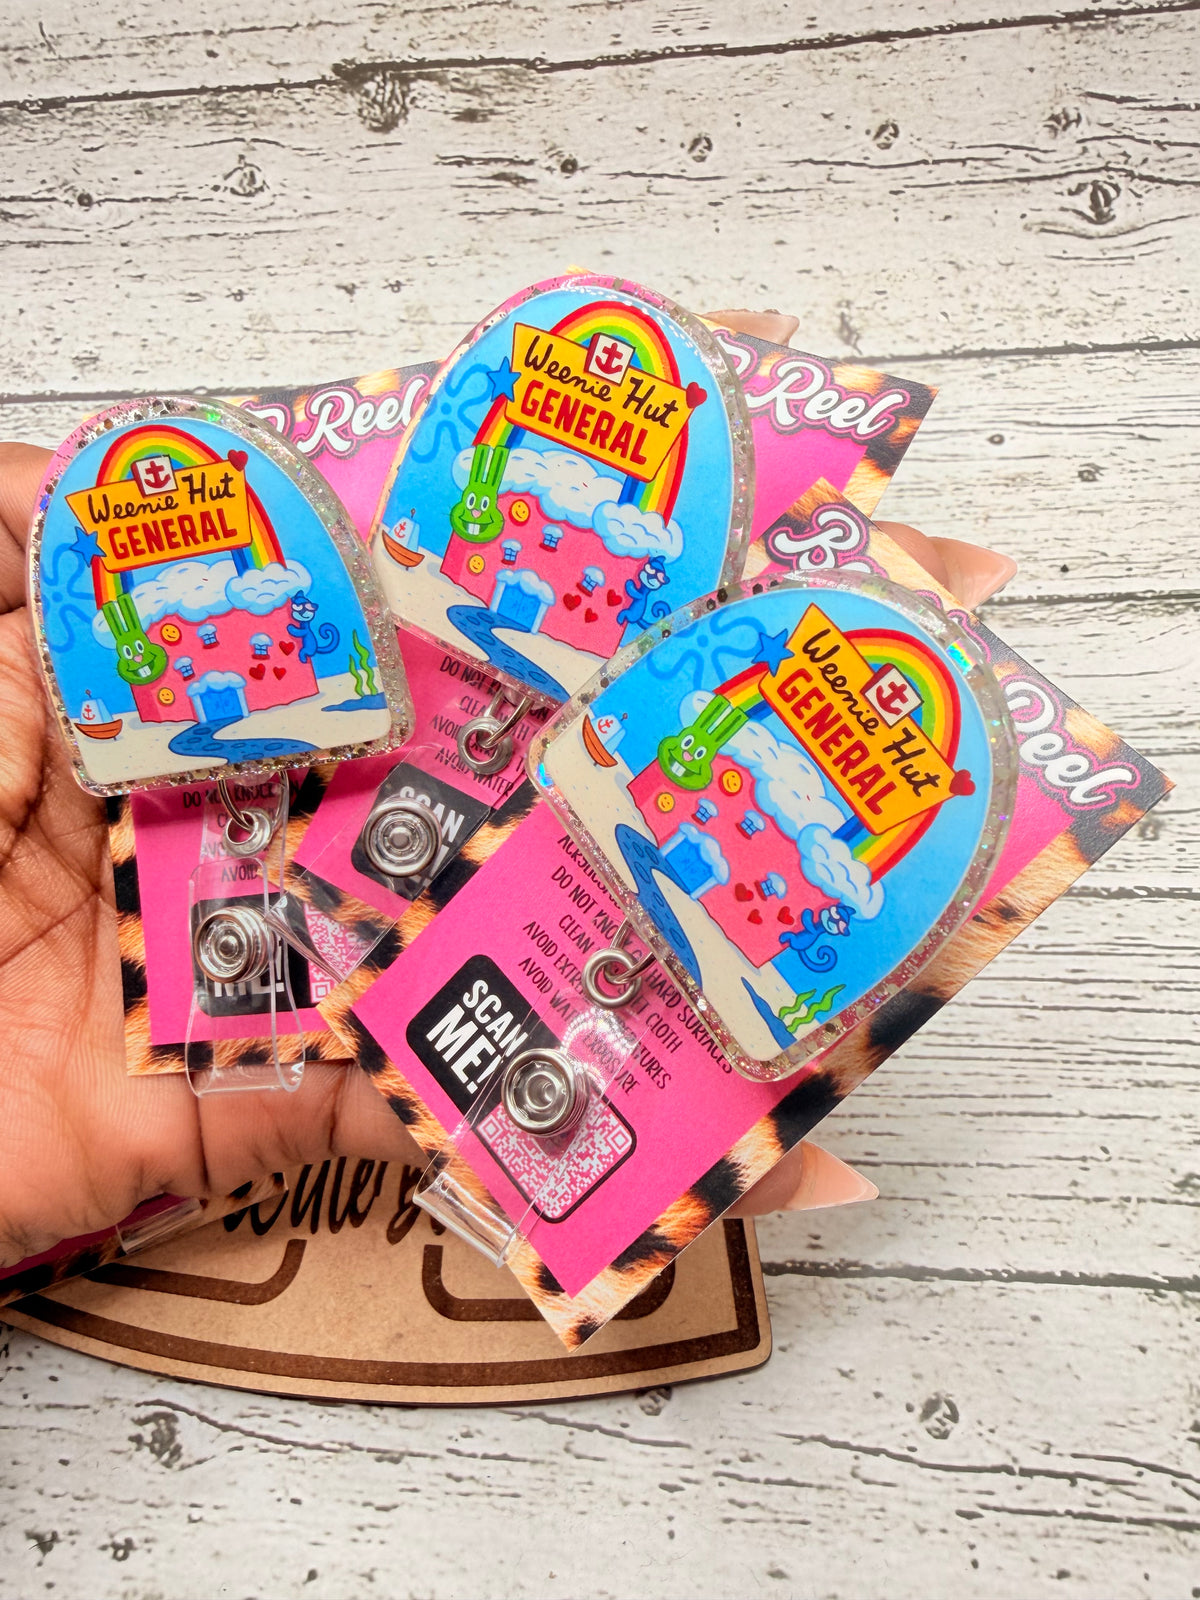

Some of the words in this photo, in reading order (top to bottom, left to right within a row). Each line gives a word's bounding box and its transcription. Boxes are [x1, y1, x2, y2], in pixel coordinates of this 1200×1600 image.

[296, 379, 425, 453] Reel
[524, 335, 612, 401] Weenie
[622, 377, 679, 428] Hut
[746, 361, 904, 435] Reel
[521, 379, 649, 465] GENERAL
[87, 494, 179, 524] Weenie
[181, 472, 236, 505] Hut
[108, 508, 238, 560] GENERAL
[440, 656, 460, 676] DO
[460, 695, 488, 717] CLEA
[777, 668, 897, 816] GENERAL
[802, 628, 879, 736] Weenie
[882, 727, 941, 797] Hut
[183, 791, 201, 808] DO
[473, 771, 515, 797] WATER
[523, 921, 558, 957] AVOID
[551, 865, 573, 889] DO
[568, 884, 598, 914] NOT
[645, 968, 682, 1008] HARD
[518, 957, 553, 994] AVOID
[558, 914, 595, 954] CLEAN
[645, 1012, 684, 1053] CLOTH
[426, 1004, 501, 1094] ME!
[463, 980, 528, 1057] SCAN
